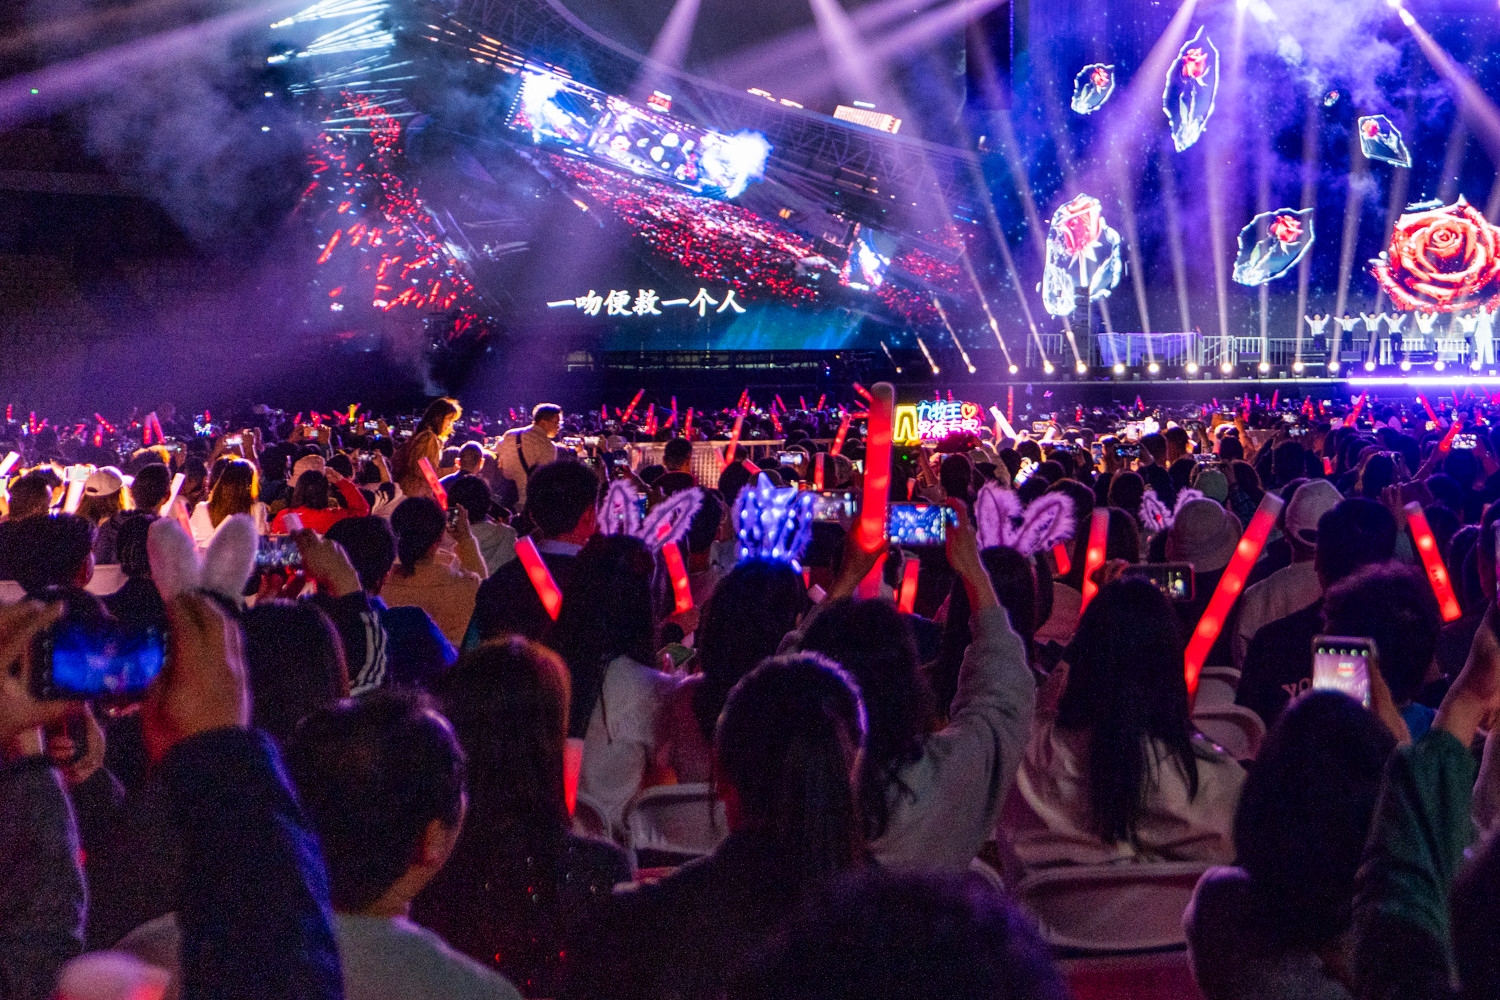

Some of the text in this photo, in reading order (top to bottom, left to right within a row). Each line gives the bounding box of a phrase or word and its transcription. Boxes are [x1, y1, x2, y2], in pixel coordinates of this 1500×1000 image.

[546, 287, 746, 317] 一吻便救一个人
[916, 402, 963, 422] 九牧王
[916, 418, 979, 439] 男裤专家
